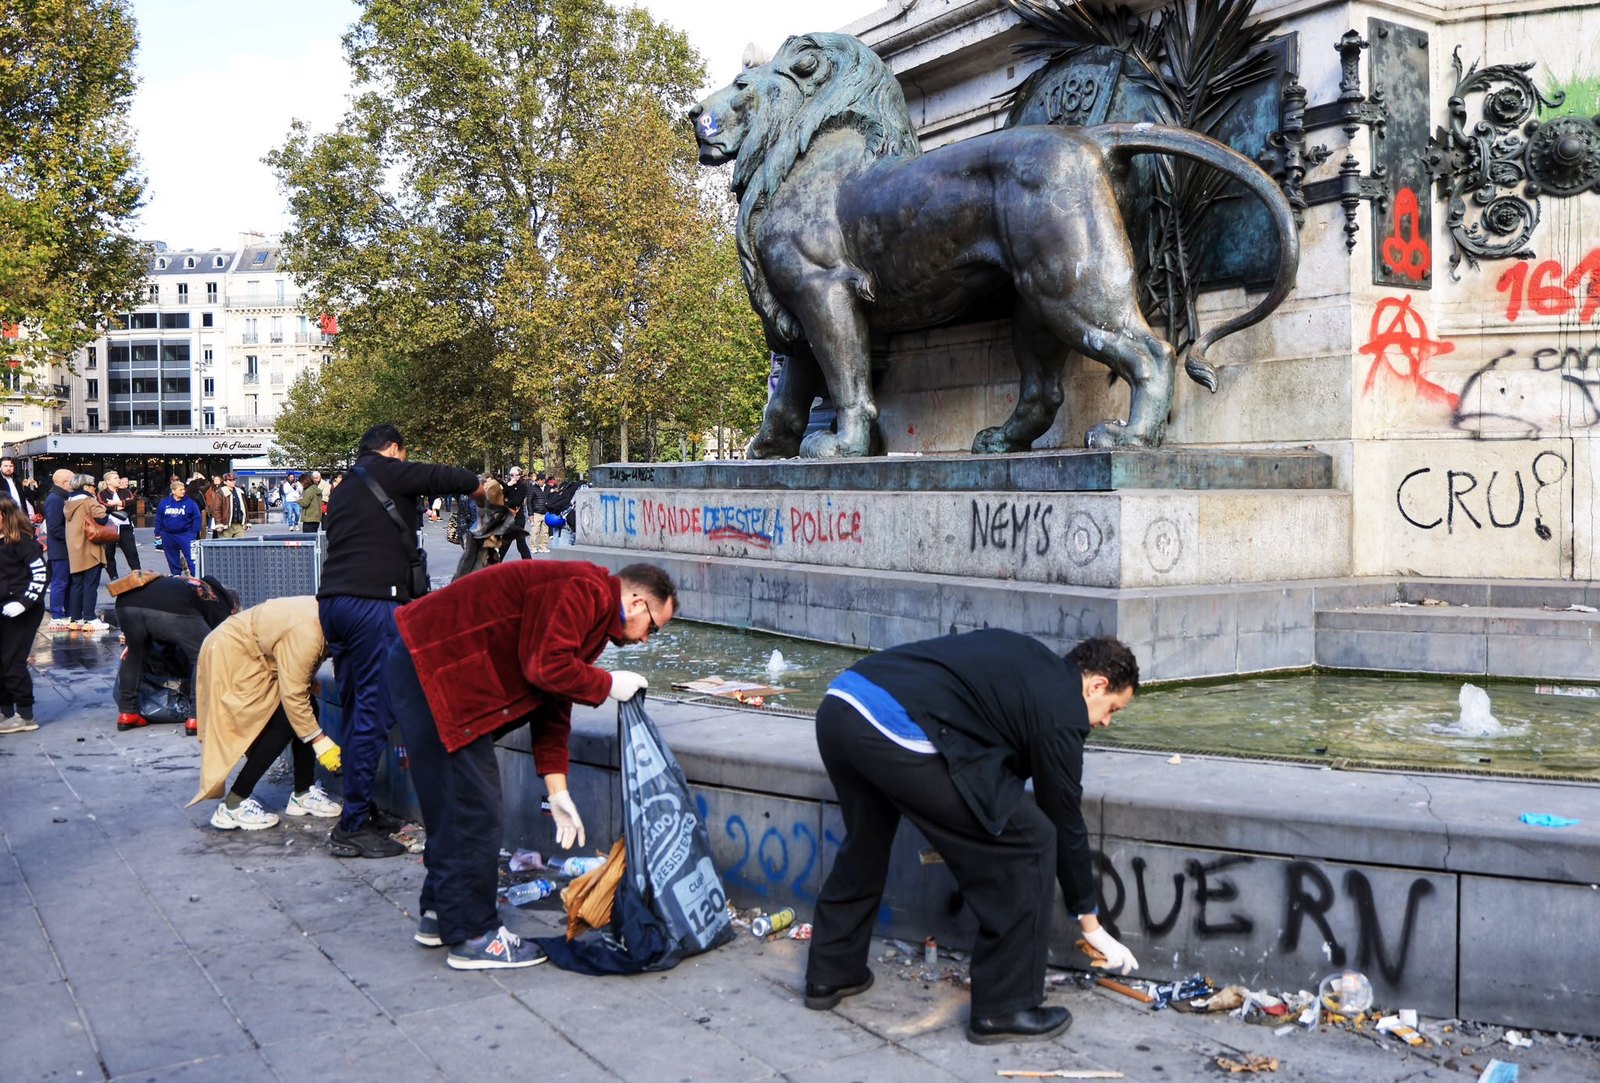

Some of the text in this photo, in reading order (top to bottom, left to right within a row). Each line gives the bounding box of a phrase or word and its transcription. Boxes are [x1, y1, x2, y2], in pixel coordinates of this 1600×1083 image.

[642, 499, 702, 536] MONDE
[790, 506, 862, 543] POLICE
[25, 557, 47, 601] VIBES
[688, 887, 725, 936] 120
